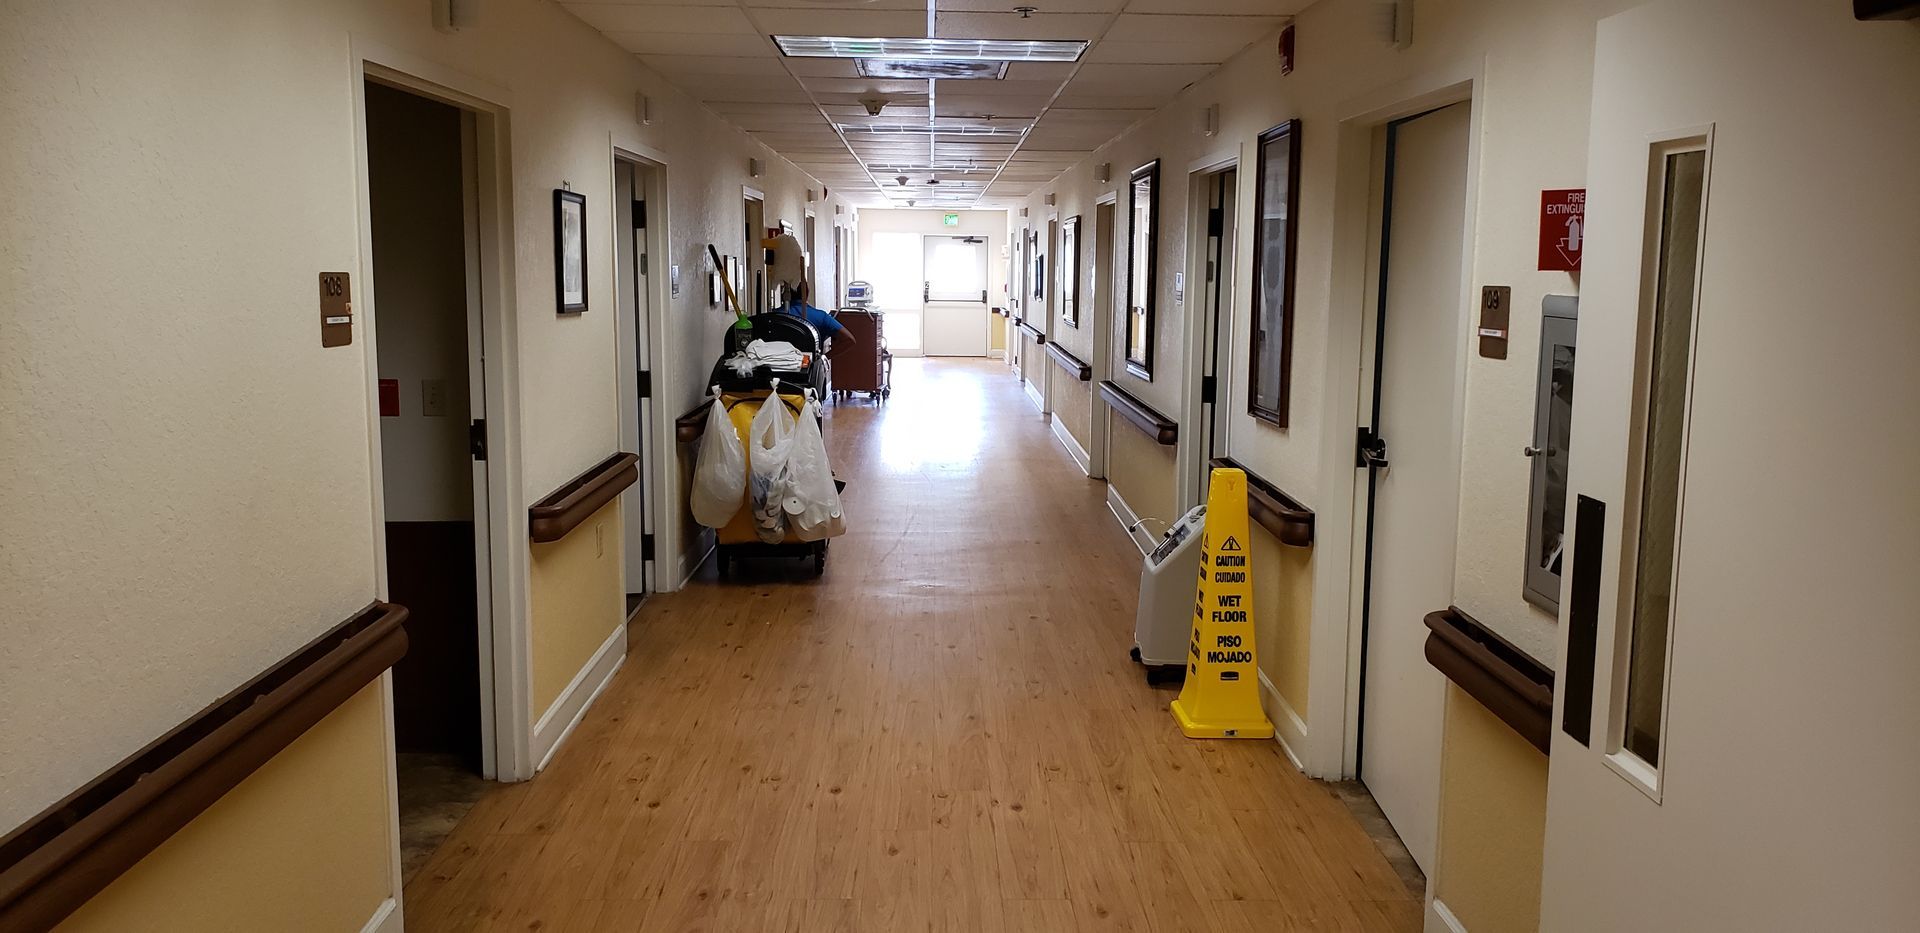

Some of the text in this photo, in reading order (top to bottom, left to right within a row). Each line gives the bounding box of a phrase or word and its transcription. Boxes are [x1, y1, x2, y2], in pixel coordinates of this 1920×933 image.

[1568, 193, 1585, 203] FIRE
[324, 276, 342, 296] 108
[1216, 556, 1246, 567] CAUTION
[1215, 572, 1246, 583] CUIDADO
[1218, 595, 1242, 607] WET
[1212, 611, 1247, 623] FLOOR
[1217, 635, 1242, 648] PISO
[1207, 651, 1252, 663] MOJADO
